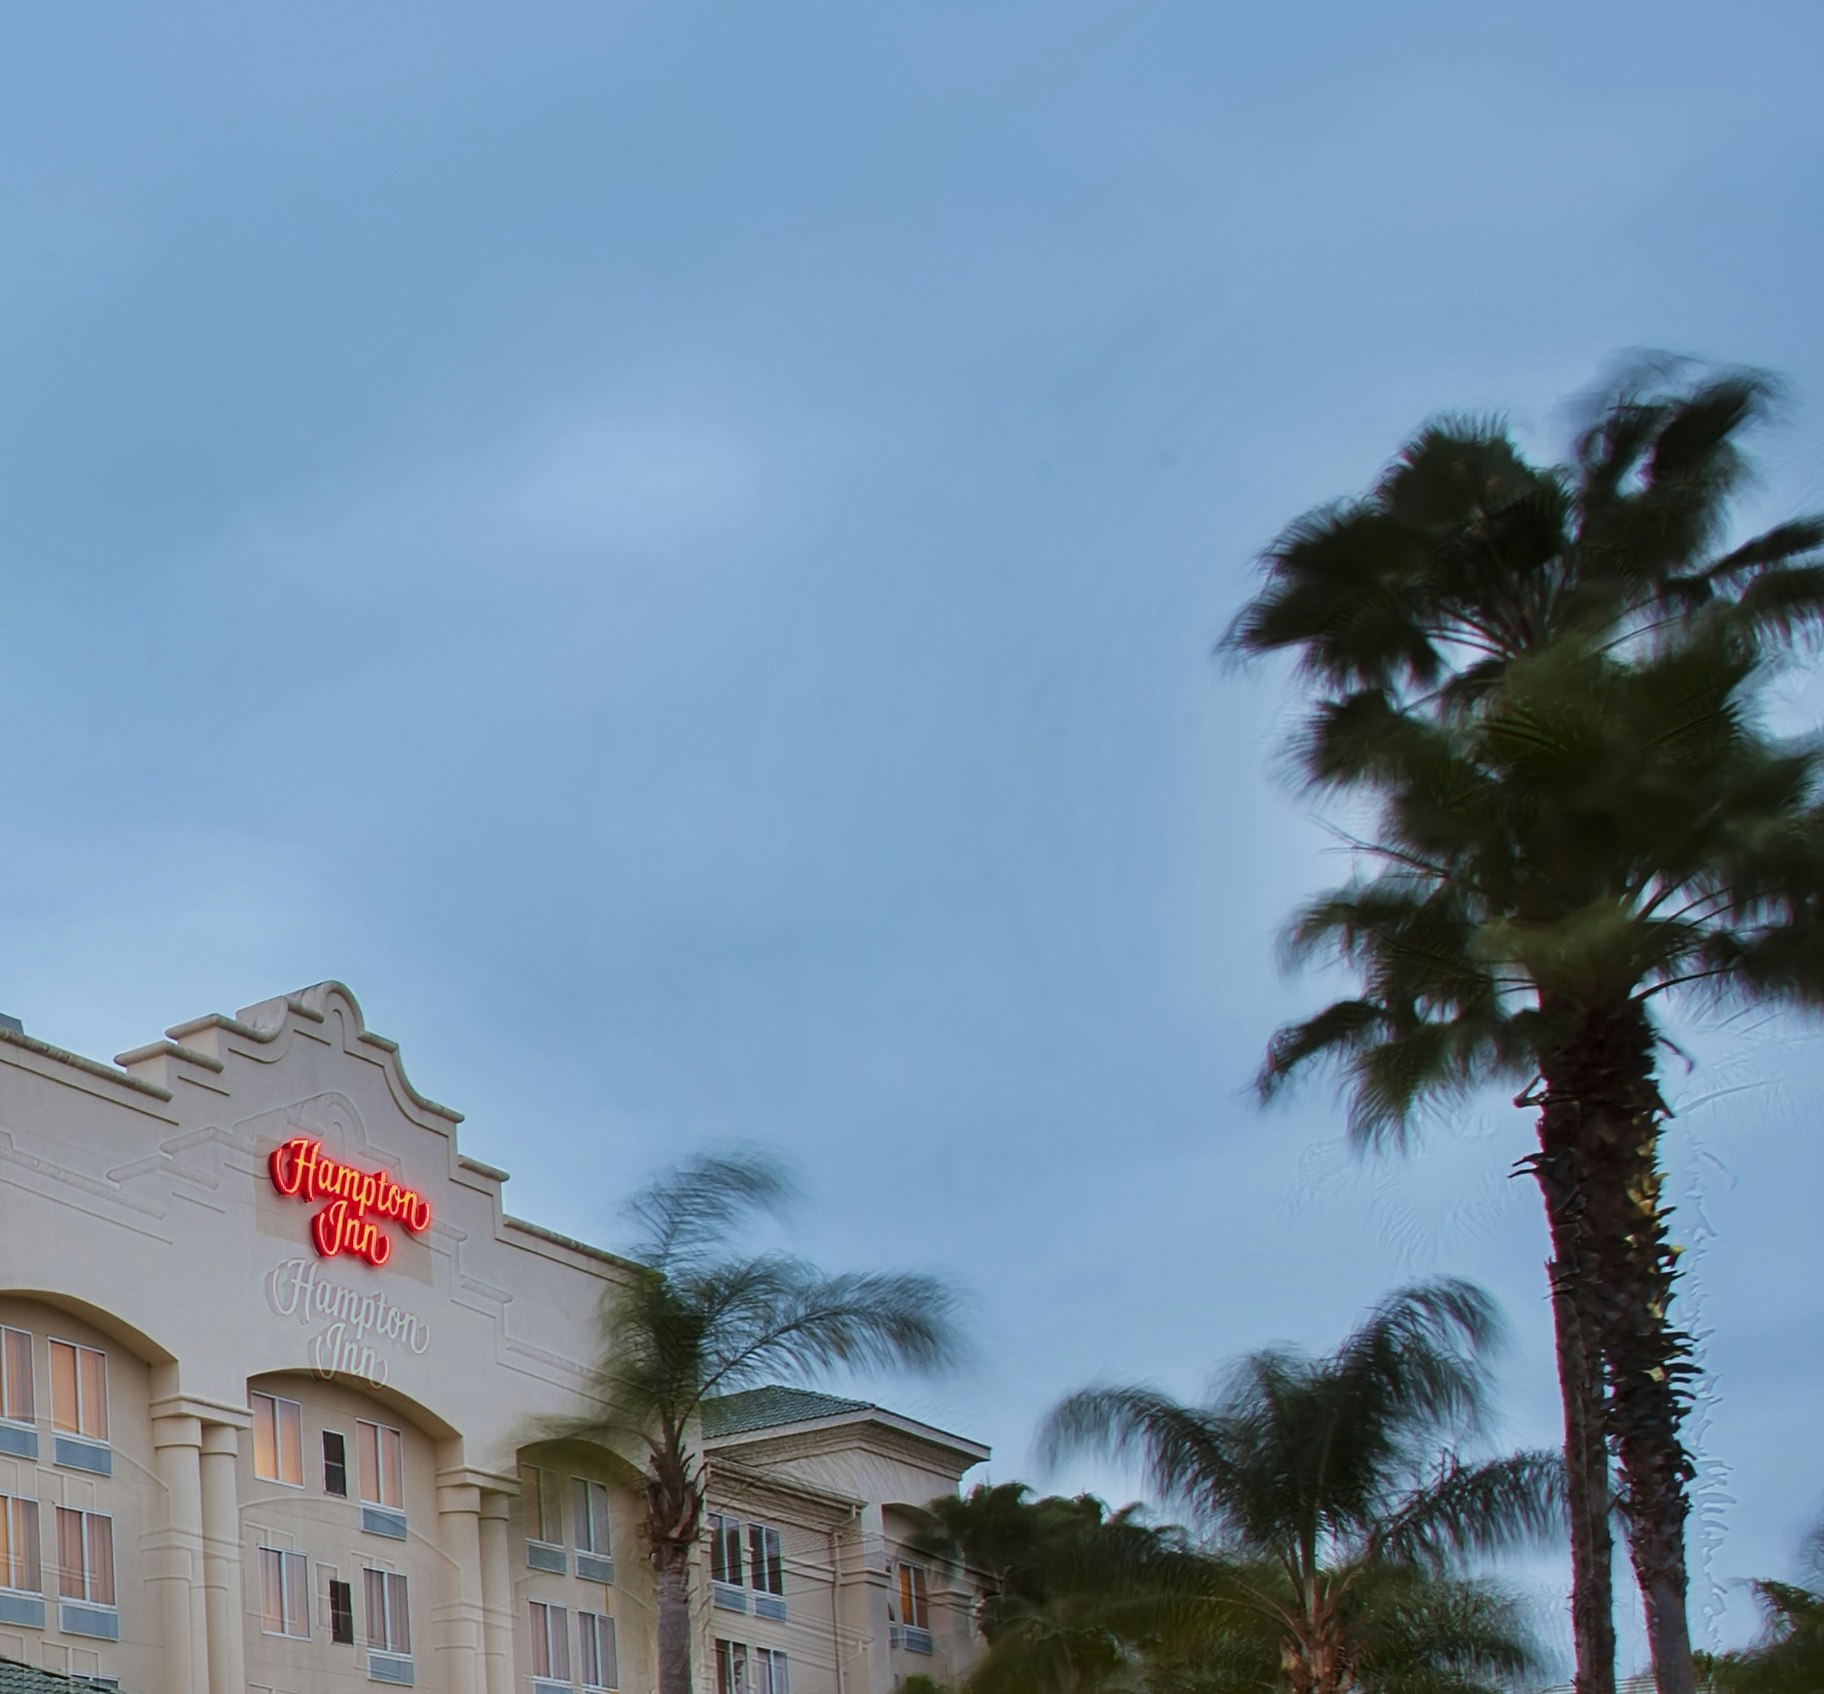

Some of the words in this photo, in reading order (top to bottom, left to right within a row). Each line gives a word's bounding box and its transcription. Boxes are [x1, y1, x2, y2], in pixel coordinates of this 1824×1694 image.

[268, 1138, 431, 1232] Hampton
[312, 1199, 391, 1266] Inn
[266, 1257, 430, 1355] Hampton
